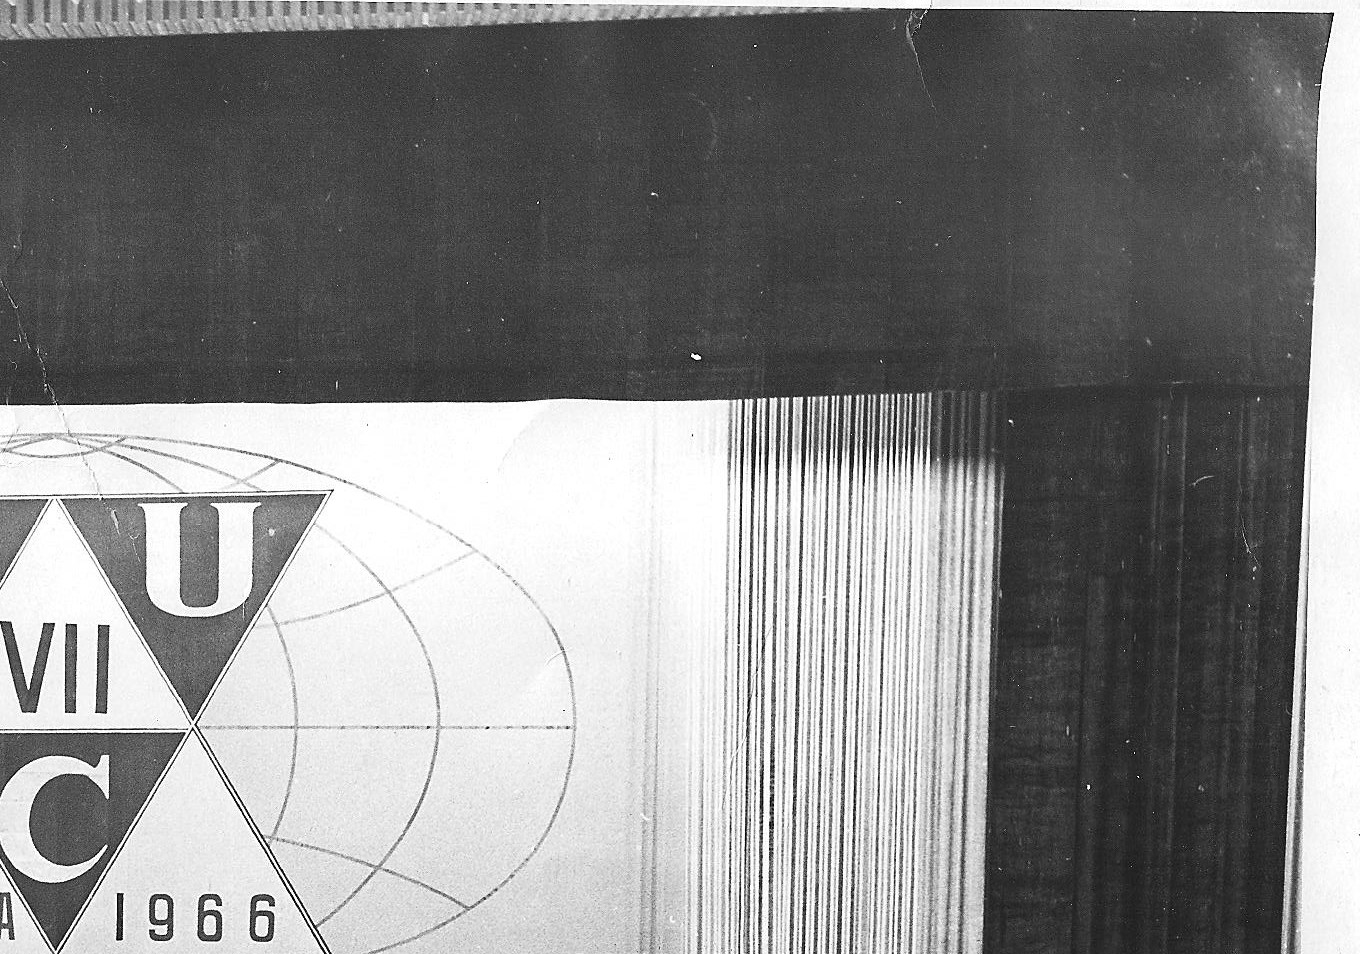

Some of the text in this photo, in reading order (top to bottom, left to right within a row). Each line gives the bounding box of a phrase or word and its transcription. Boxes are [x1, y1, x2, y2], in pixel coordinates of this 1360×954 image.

[138, 501, 262, 618] U
[0, 621, 110, 714] VII
[115, 892, 276, 943] 1966
